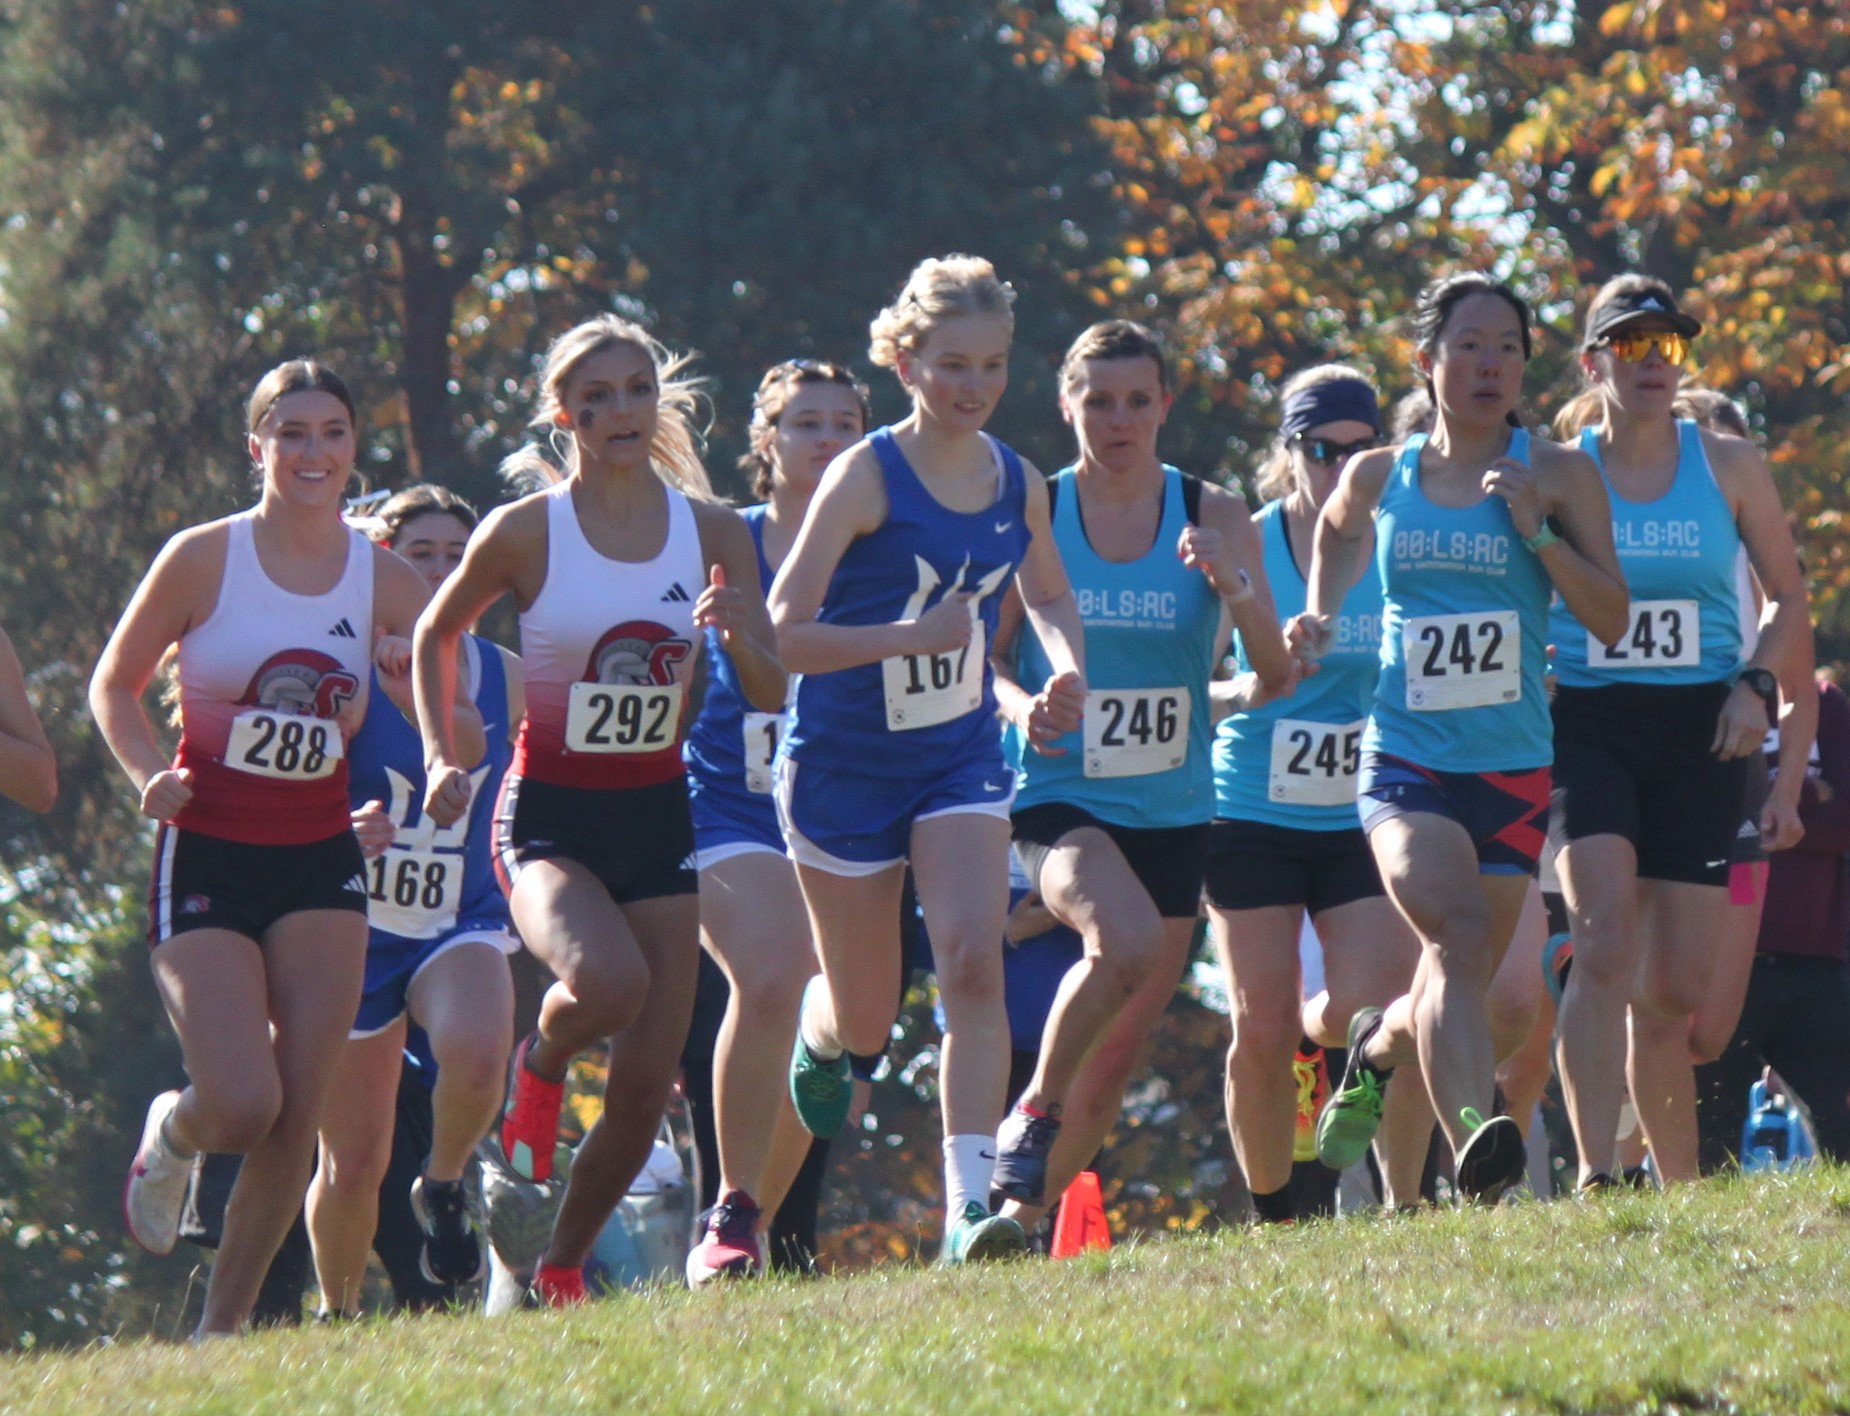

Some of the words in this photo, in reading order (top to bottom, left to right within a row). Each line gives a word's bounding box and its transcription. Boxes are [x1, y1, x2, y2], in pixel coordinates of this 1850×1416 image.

[1071, 588, 1177, 619] 0:LS:RC
[1420, 620, 1504, 677] 242
[1604, 608, 1684, 659] 43
[243, 715, 327, 774] 288
[584, 692, 671, 745] 292
[1100, 696, 1178, 747] 246
[1287, 728, 1361, 778] 245
[368, 854, 447, 910] 168
